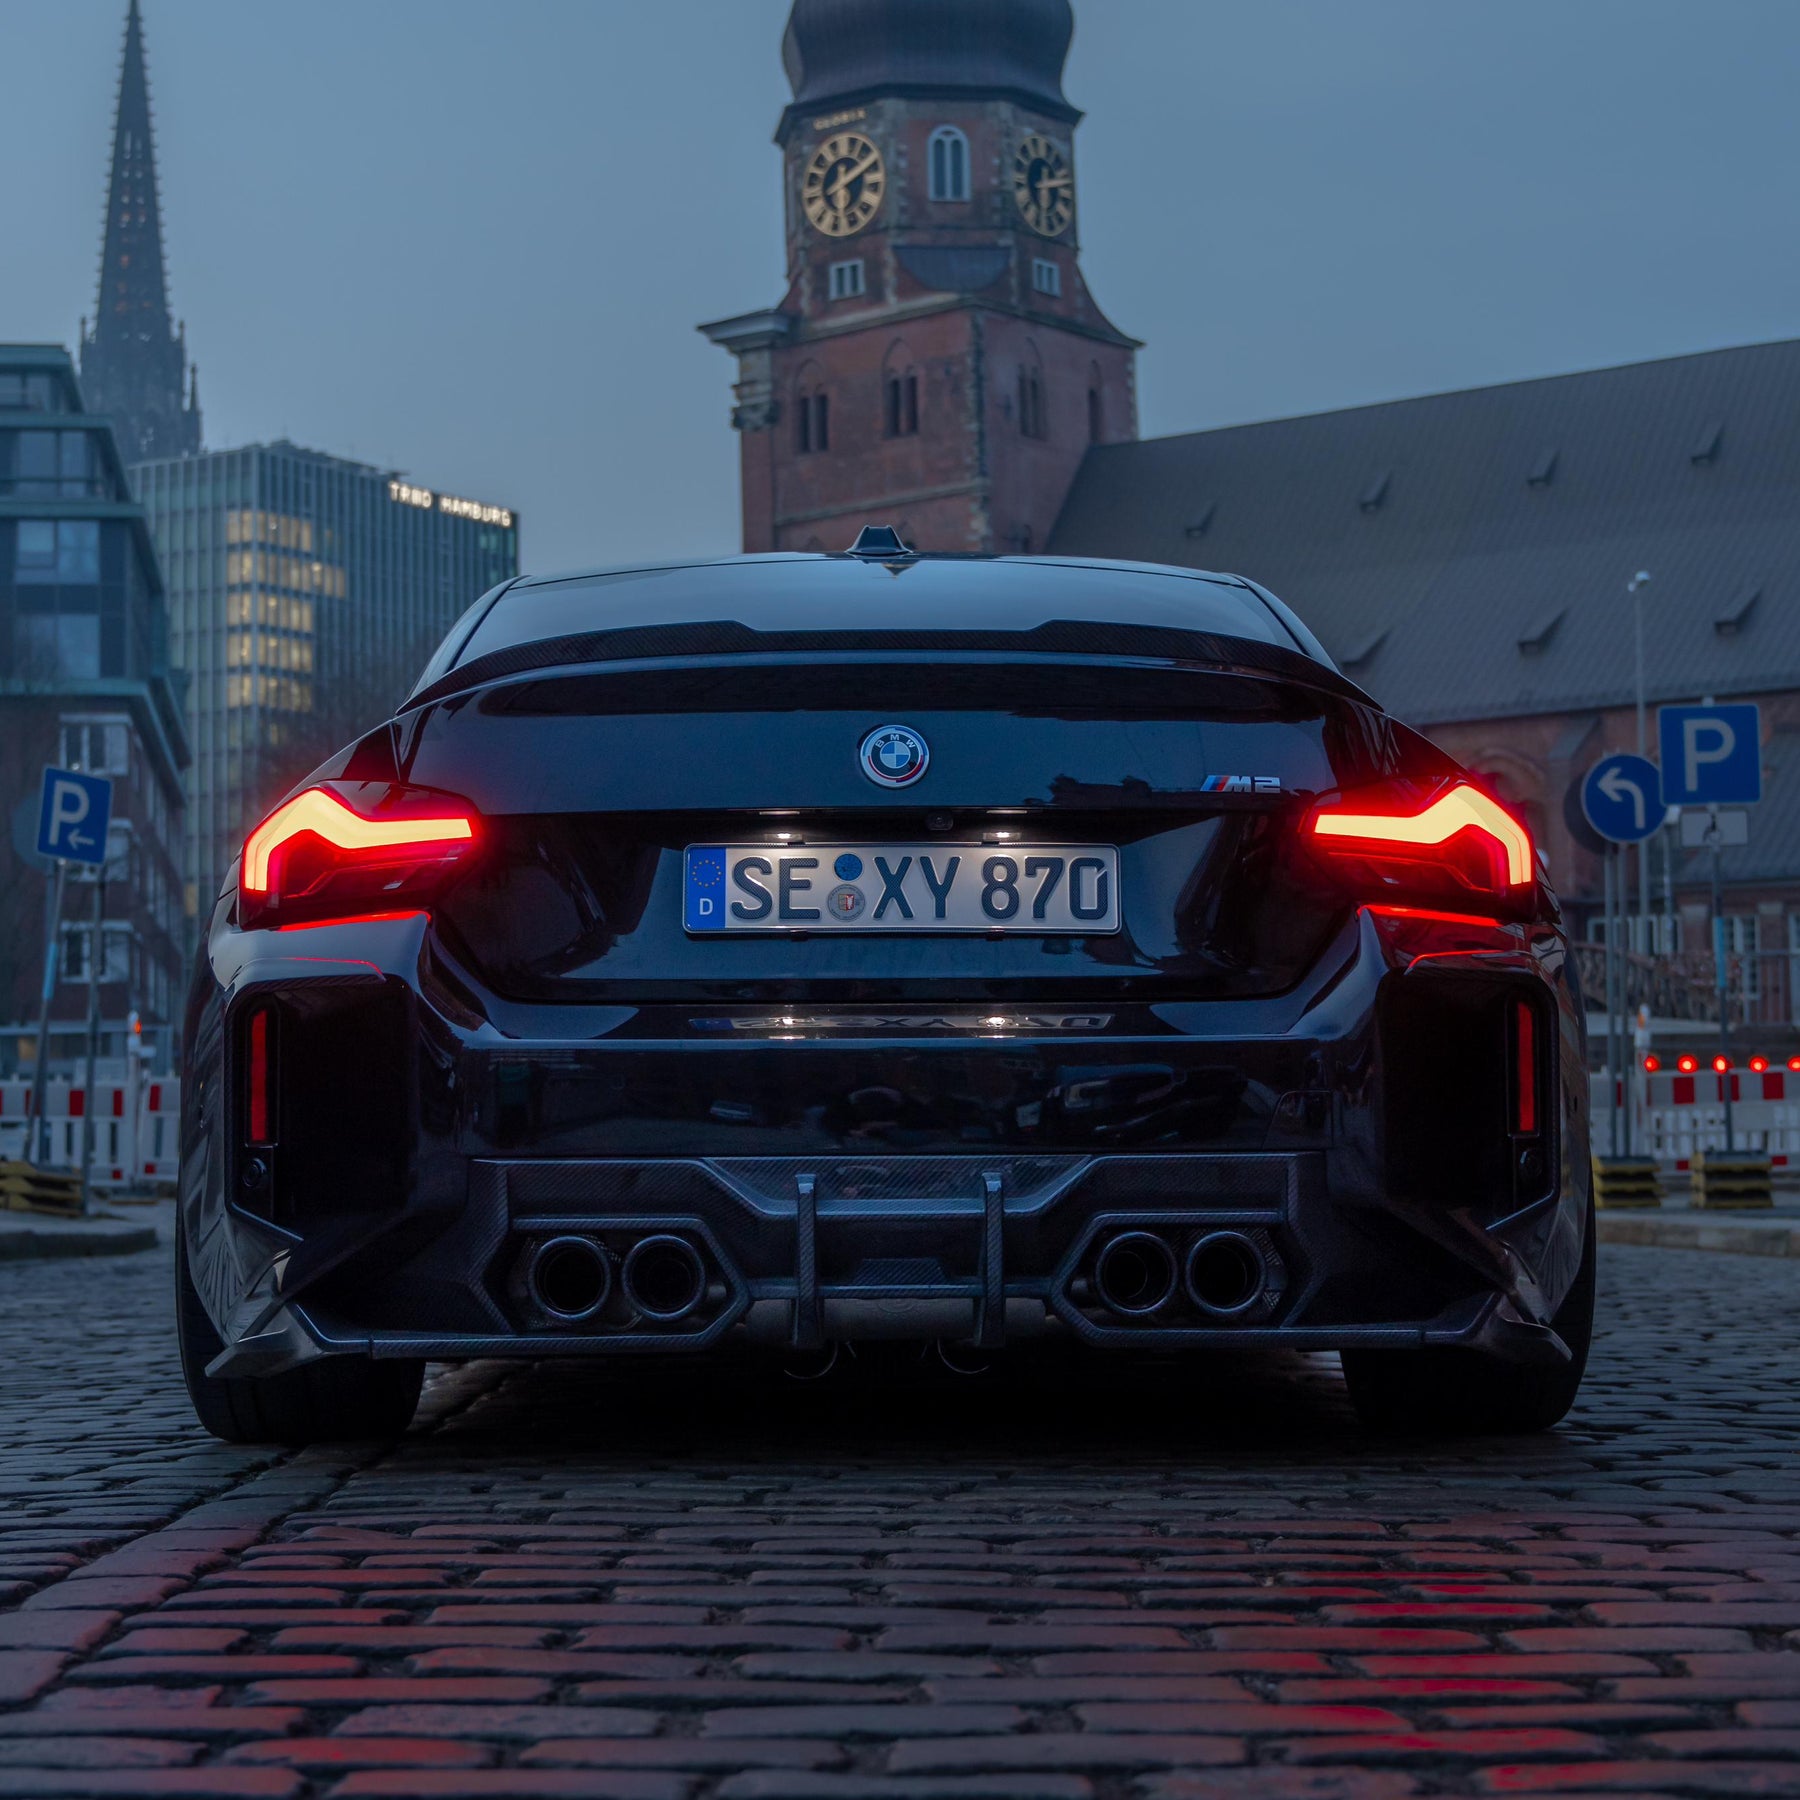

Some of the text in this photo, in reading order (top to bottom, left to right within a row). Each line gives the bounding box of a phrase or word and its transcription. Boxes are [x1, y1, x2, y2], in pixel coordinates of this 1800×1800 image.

[440, 495, 511, 528] HAMBURG
[875, 734, 916, 749] BMW
[1683, 718, 1736, 792] P
[48, 780, 89, 846] P
[699, 898, 713, 915] D
[731, 856, 820, 920] SE
[872, 856, 961, 919] XY
[981, 856, 1108, 920] 870
